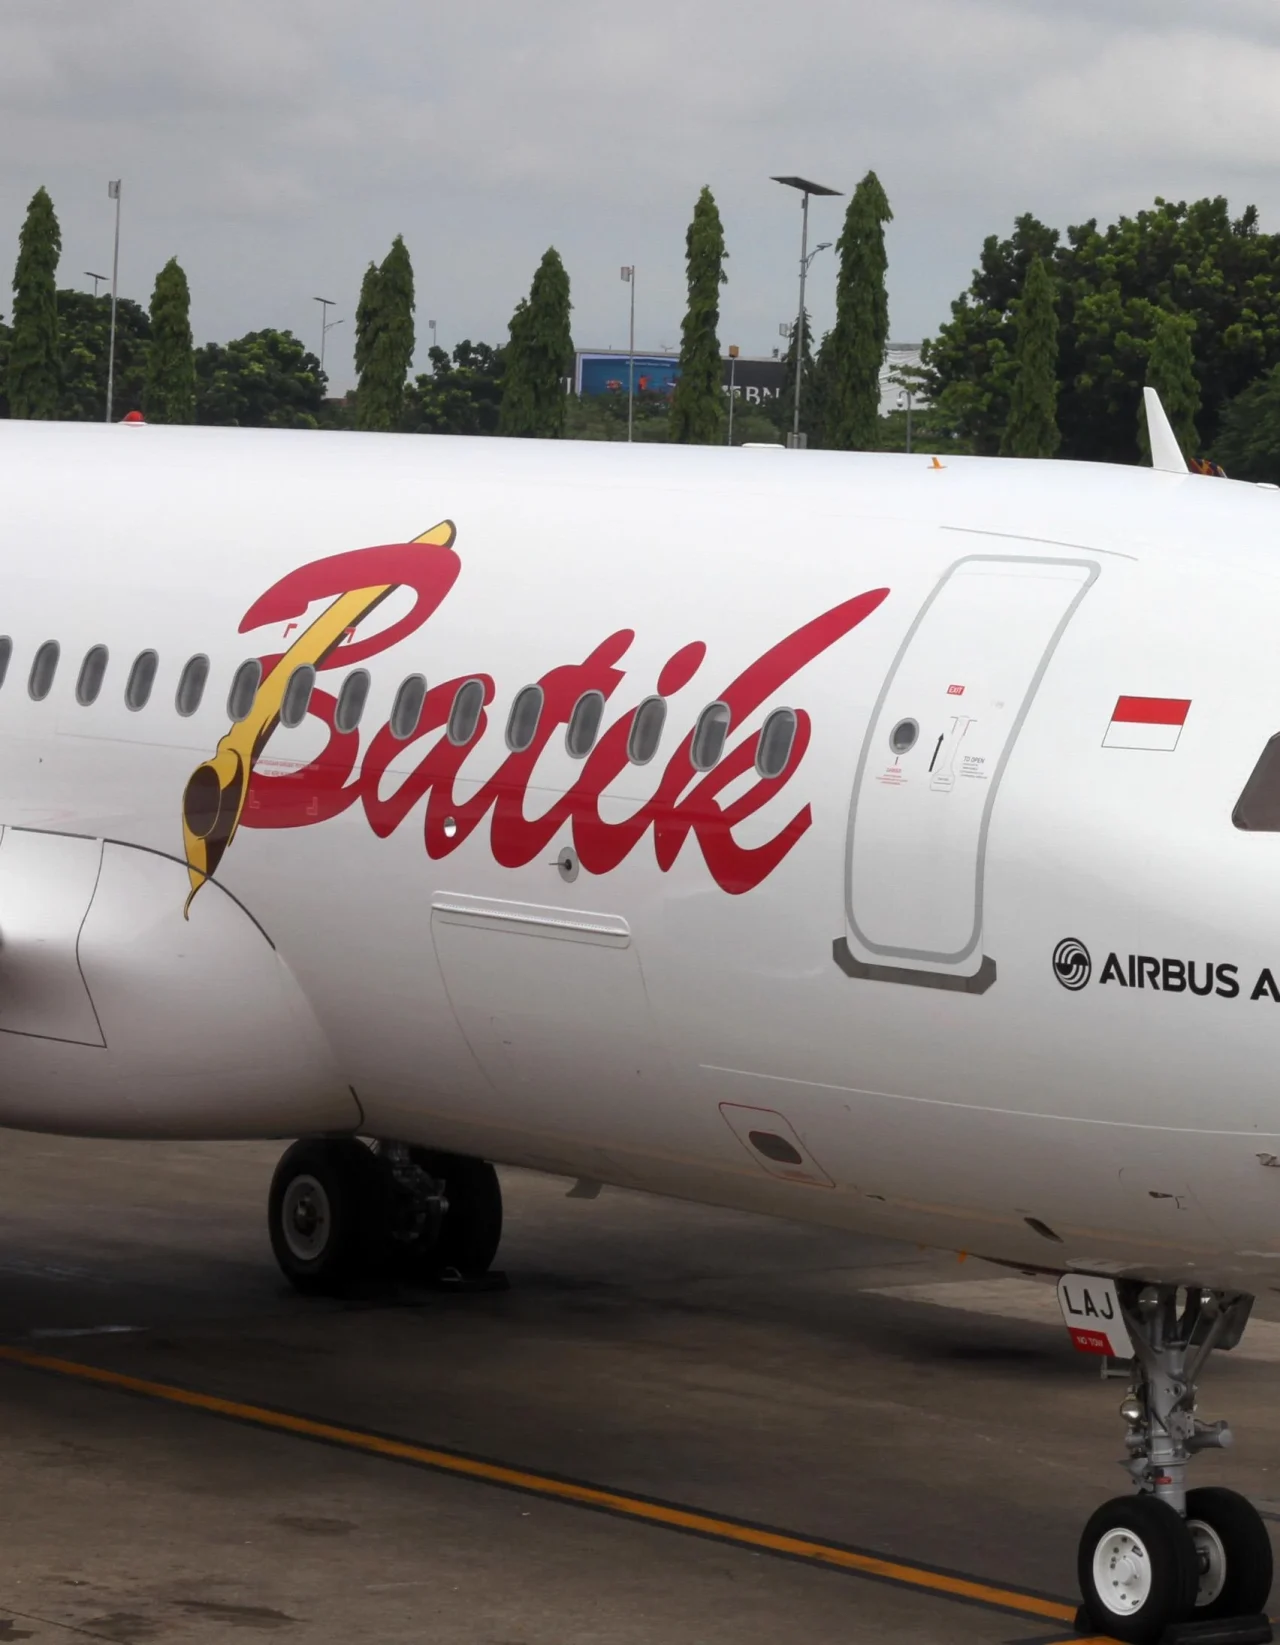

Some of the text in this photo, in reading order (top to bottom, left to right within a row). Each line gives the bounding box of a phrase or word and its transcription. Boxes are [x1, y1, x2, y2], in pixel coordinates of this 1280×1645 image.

[949, 686, 963, 695] EXIT
[184, 520, 891, 918] Batik
[1099, 952, 1240, 999] AIRBUS
[1062, 1285, 1115, 1320] LAJ
